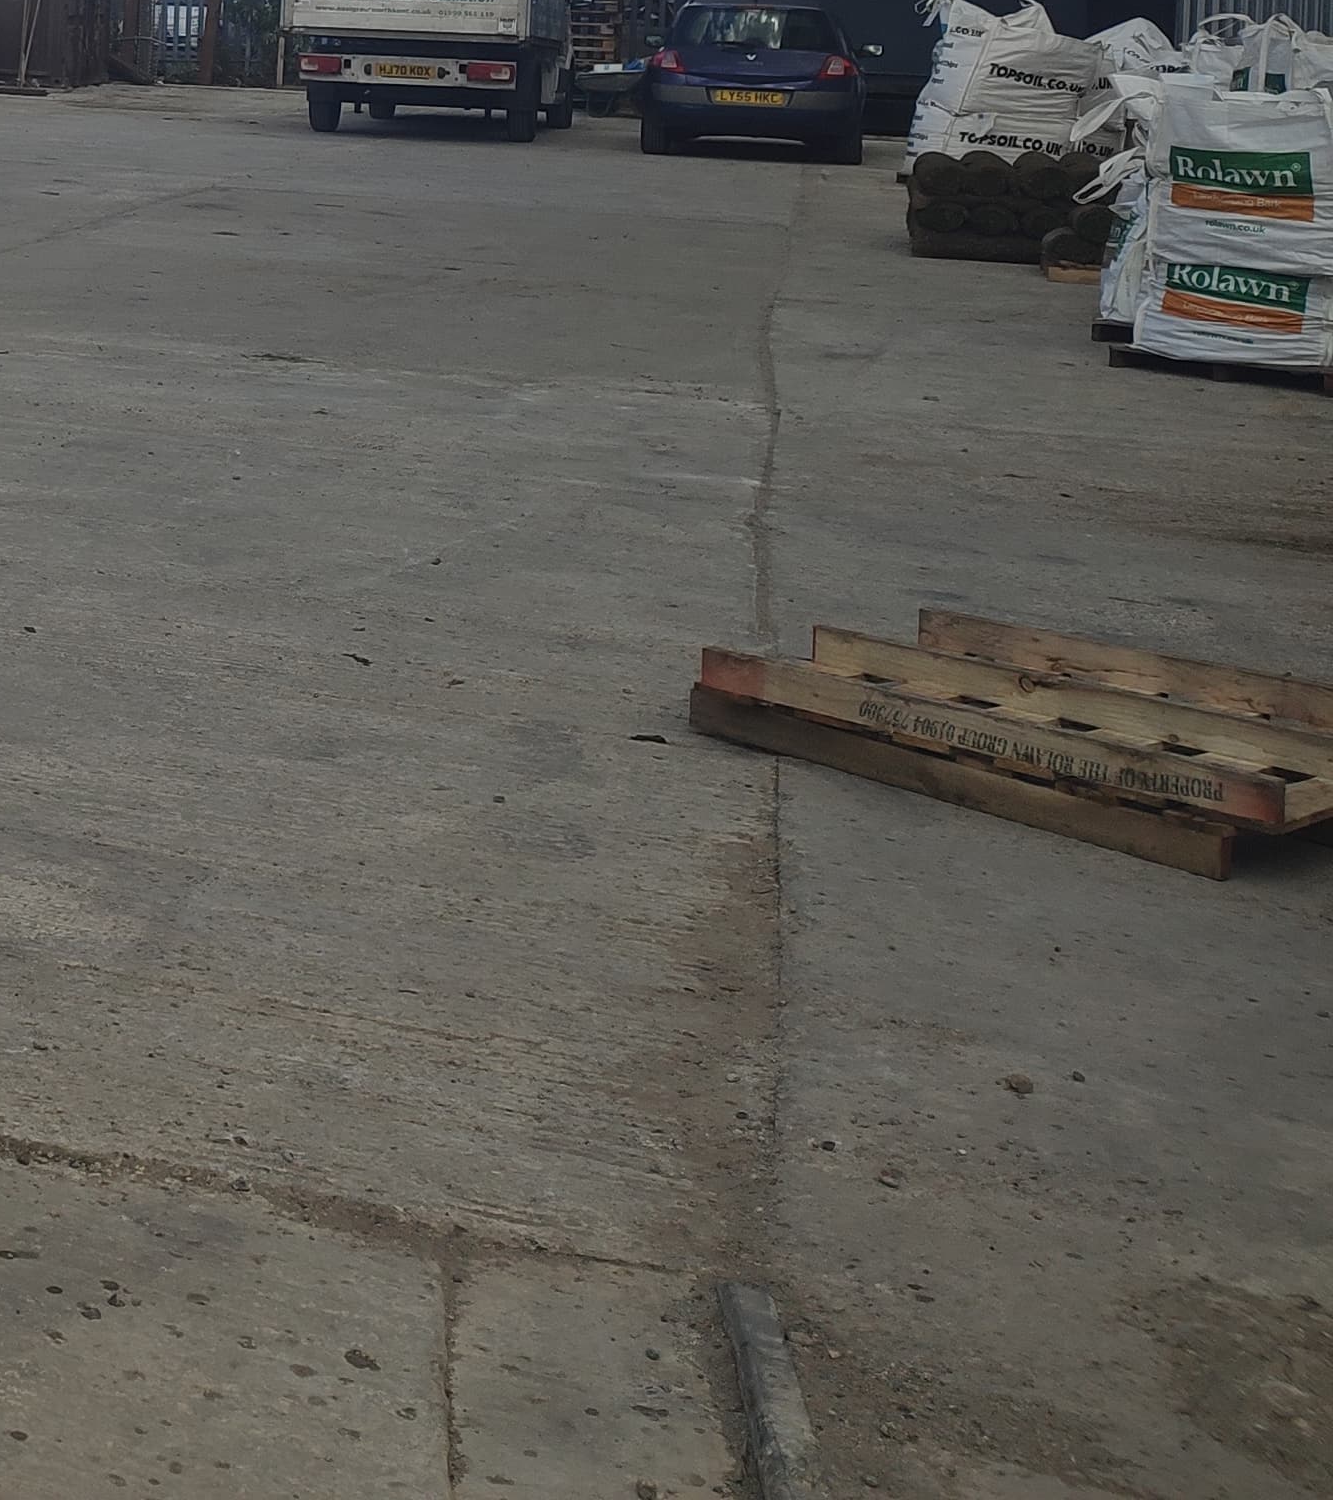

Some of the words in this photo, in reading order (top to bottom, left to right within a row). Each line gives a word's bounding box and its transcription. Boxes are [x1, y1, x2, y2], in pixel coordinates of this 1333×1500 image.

[379, 64, 407, 76] HJ70
[989, 62, 1086, 96] TOPSOIL.CO.UK
[720, 91, 752, 102] LY55
[754, 92, 778, 103] HKC
[958, 131, 1064, 157] TOPSOIL.CO.UK
[1176, 155, 1299, 188] Rolawn
[1205, 219, 1267, 235] rolawn.co.uk
[1173, 265, 1291, 303] Rolawn
[958, 728, 1008, 756] GROUP
[1014, 740, 1074, 775] ROLAWN
[1078, 757, 1109, 783] THE
